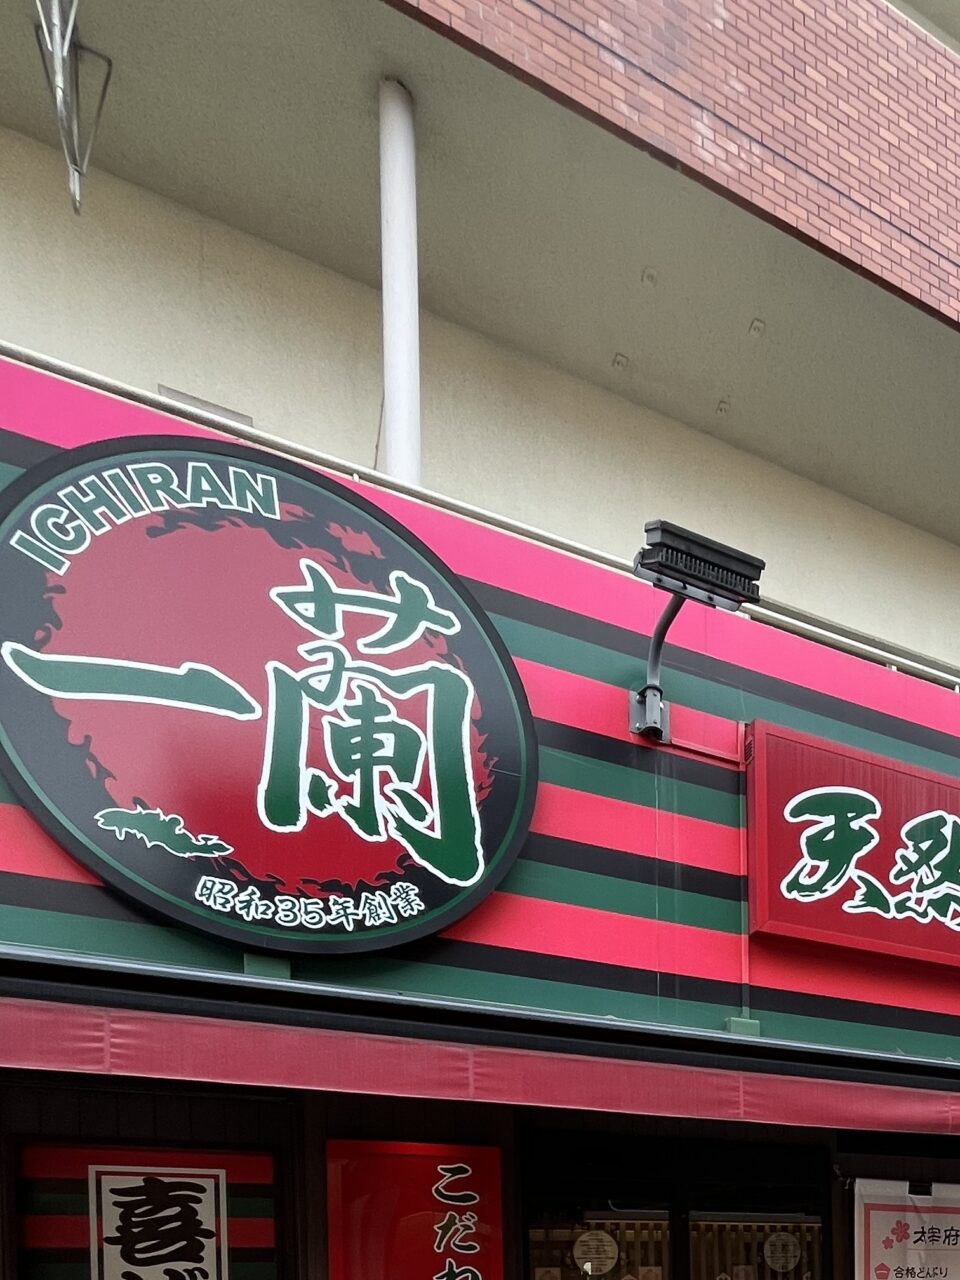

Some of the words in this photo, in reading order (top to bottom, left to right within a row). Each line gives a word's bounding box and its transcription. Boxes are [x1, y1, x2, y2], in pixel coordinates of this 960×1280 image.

[9, 461, 281, 576] ICHIRAN
[1, 558, 484, 886] 一蘭
[194, 876, 427, 931] 昭和35年創業
[893, 1266, 948, 1278] 合格どんぶり
